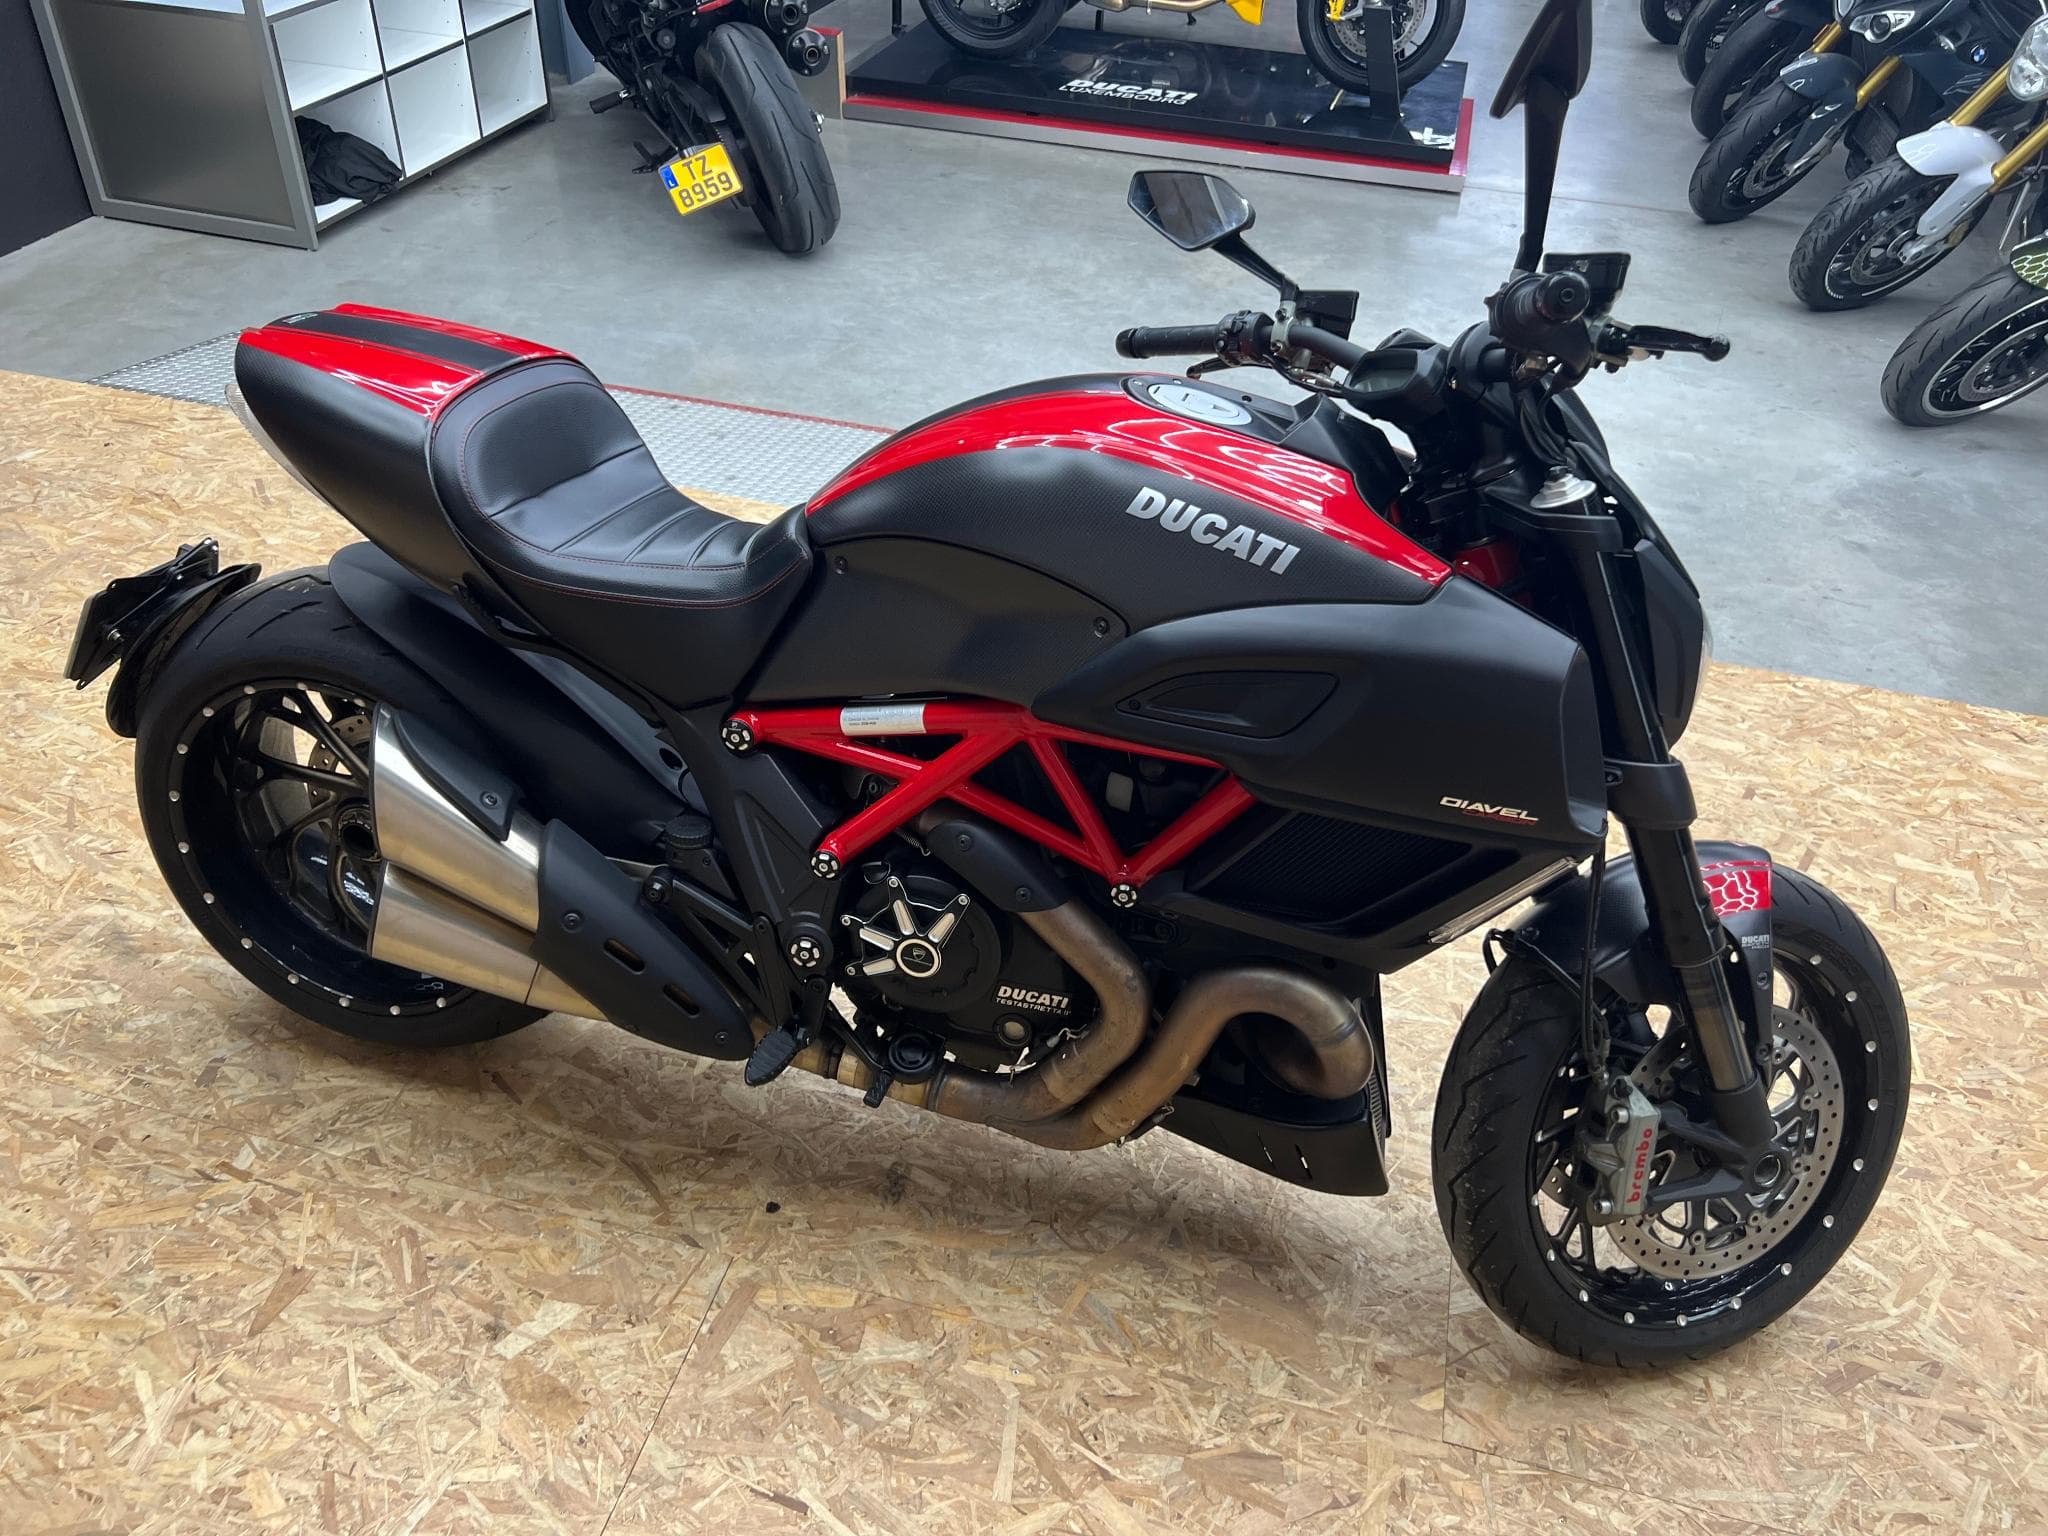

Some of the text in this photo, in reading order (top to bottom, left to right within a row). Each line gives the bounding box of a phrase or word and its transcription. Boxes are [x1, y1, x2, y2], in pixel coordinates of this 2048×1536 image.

[1059, 85, 1188, 105] LUXEMBOURG
[1066, 79, 1198, 101] DUCATI
[682, 155, 712, 181] TZ
[668, 179, 676, 187] L
[678, 171, 733, 208] 8959
[1125, 486, 1300, 575] DUCATI
[1440, 796, 1539, 821] DIAVEL
[1741, 934, 1770, 944] DUCATI
[996, 997, 1062, 1015] TESTASTRETTA
[997, 985, 1069, 1009] DUCATI
[1626, 1127, 1653, 1204] brembo
